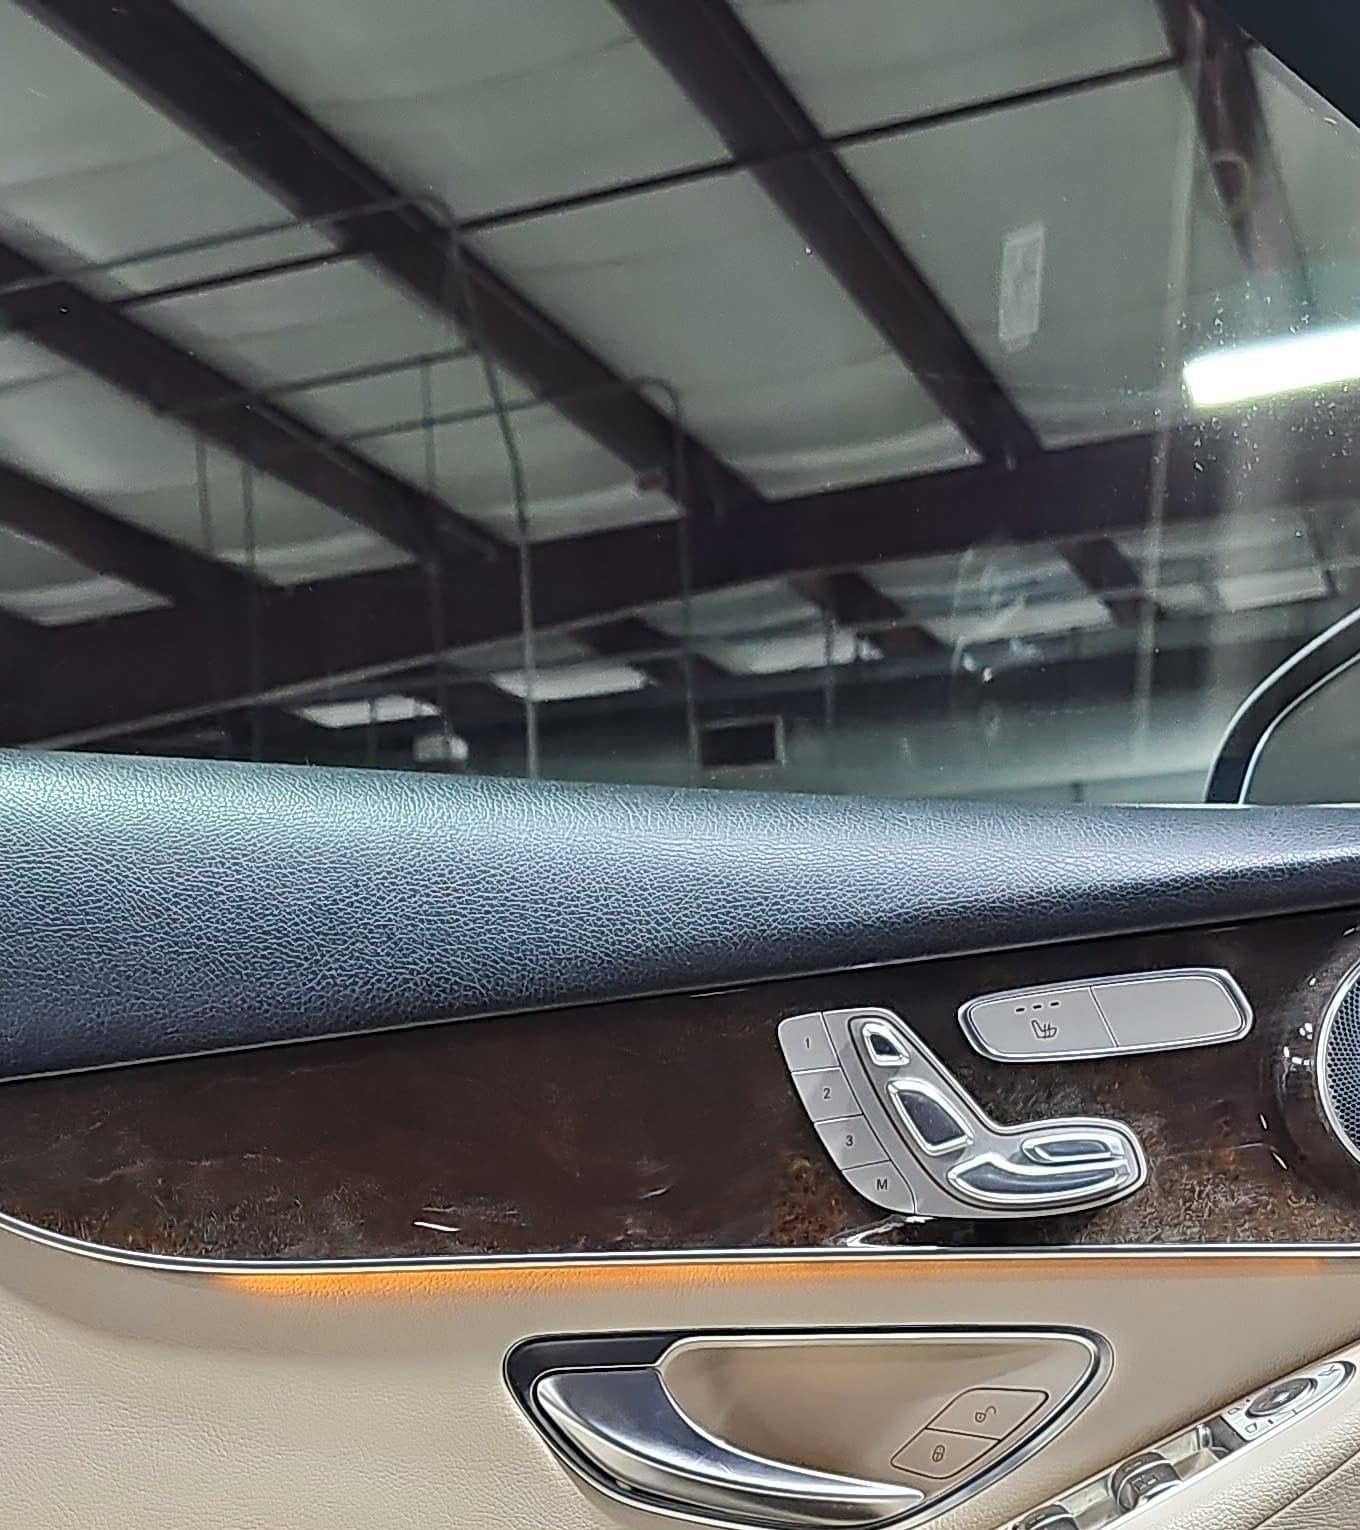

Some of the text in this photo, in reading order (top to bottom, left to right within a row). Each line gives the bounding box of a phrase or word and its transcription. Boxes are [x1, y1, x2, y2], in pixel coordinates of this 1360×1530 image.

[804, 1038, 811, 1049] 1
[823, 1088, 831, 1100] 2
[845, 1135, 854, 1146] 3
[876, 1179, 888, 1190] M
